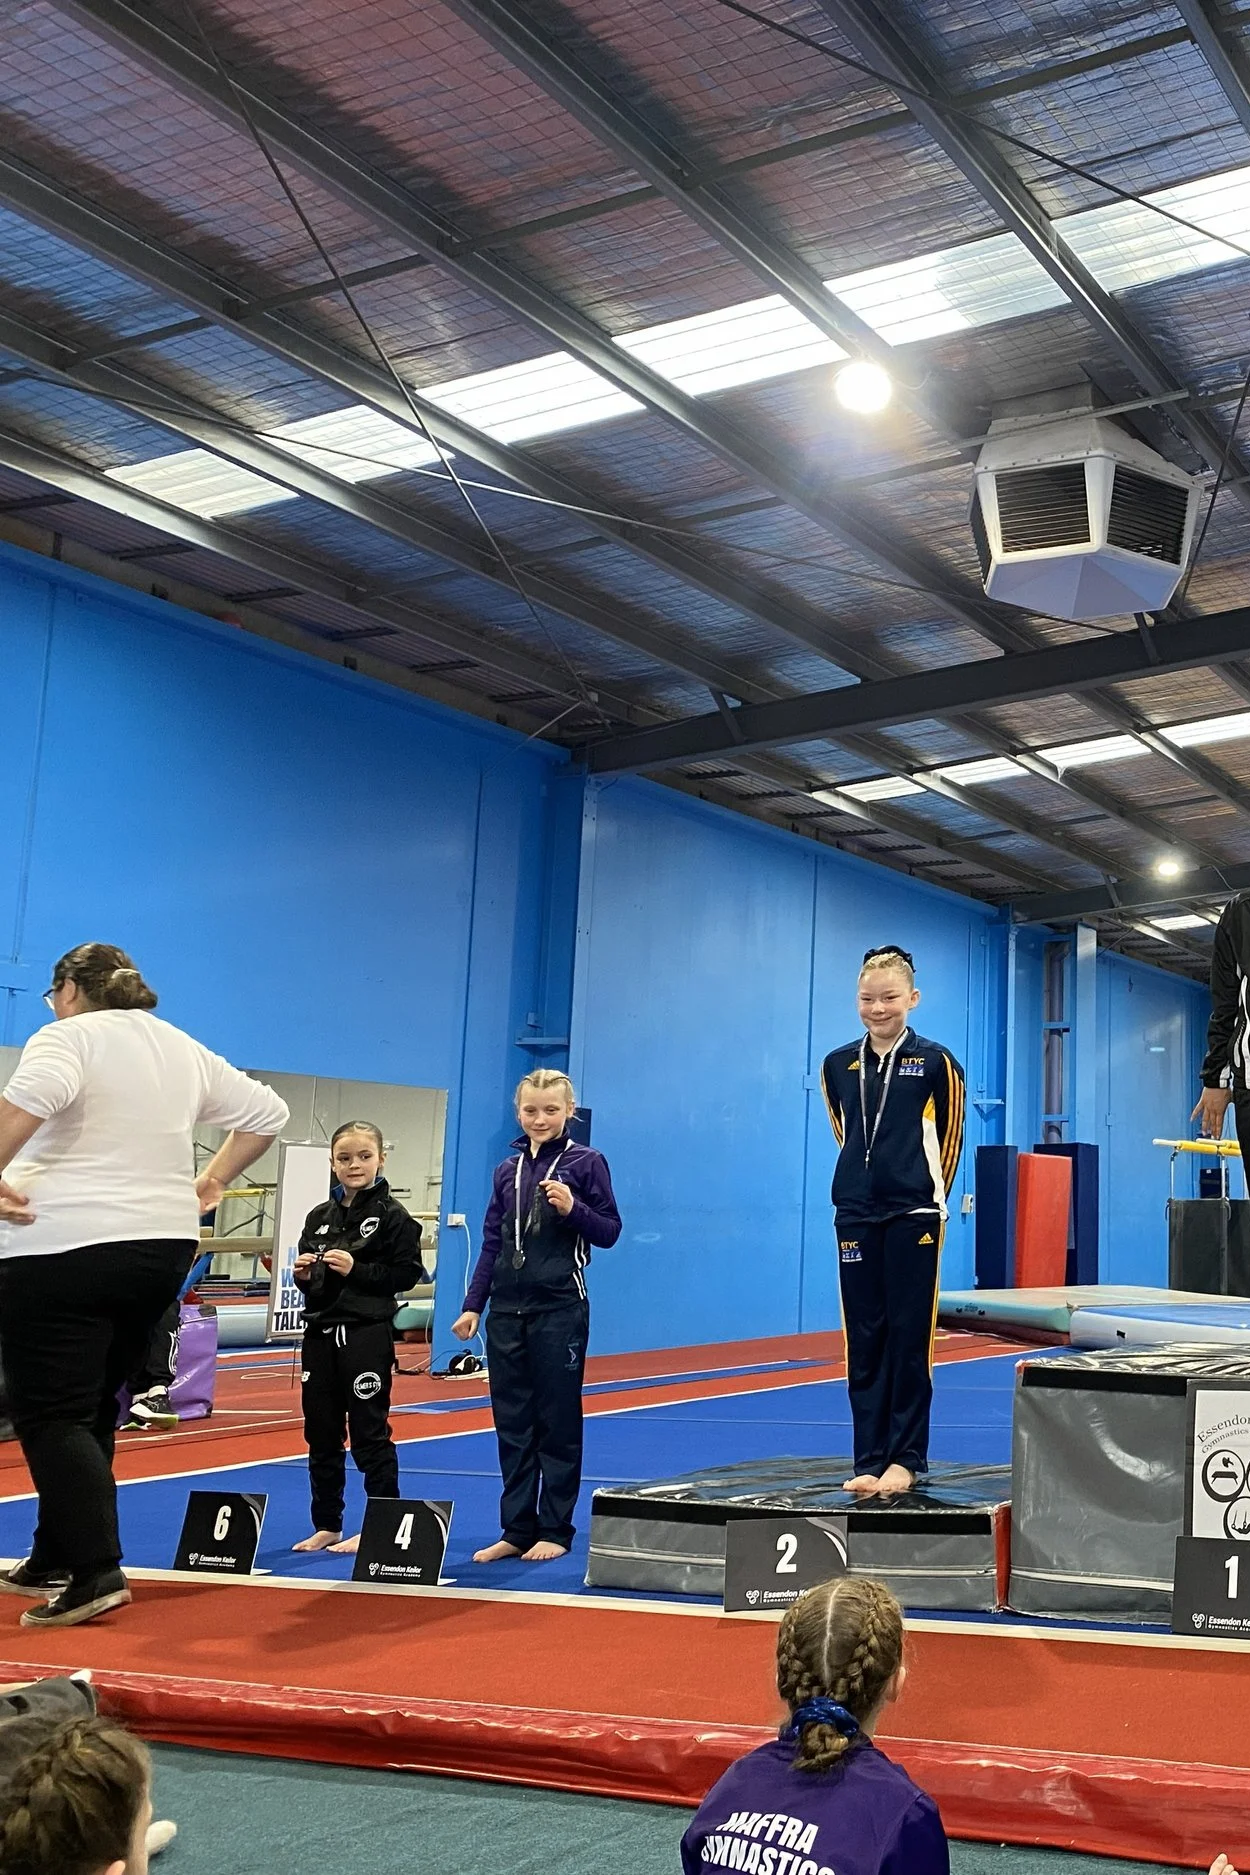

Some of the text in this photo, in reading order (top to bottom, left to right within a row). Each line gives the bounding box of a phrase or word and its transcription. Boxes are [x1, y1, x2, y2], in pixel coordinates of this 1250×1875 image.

[901, 1057, 925, 1065] BTYC
[280, 1289, 306, 1310] BEA
[274, 1310, 307, 1332] TALE
[1201, 1427, 1249, 1454] Gymnastics
[213, 1505, 232, 1541] 6
[394, 1513, 415, 1550] 4
[776, 1533, 798, 1573] 2
[1224, 1555, 1239, 1599] 1
[763, 1589, 798, 1599] Essendon
[1208, 1615, 1241, 1626] Essendon
[715, 1811, 819, 1855] MAFFRA
